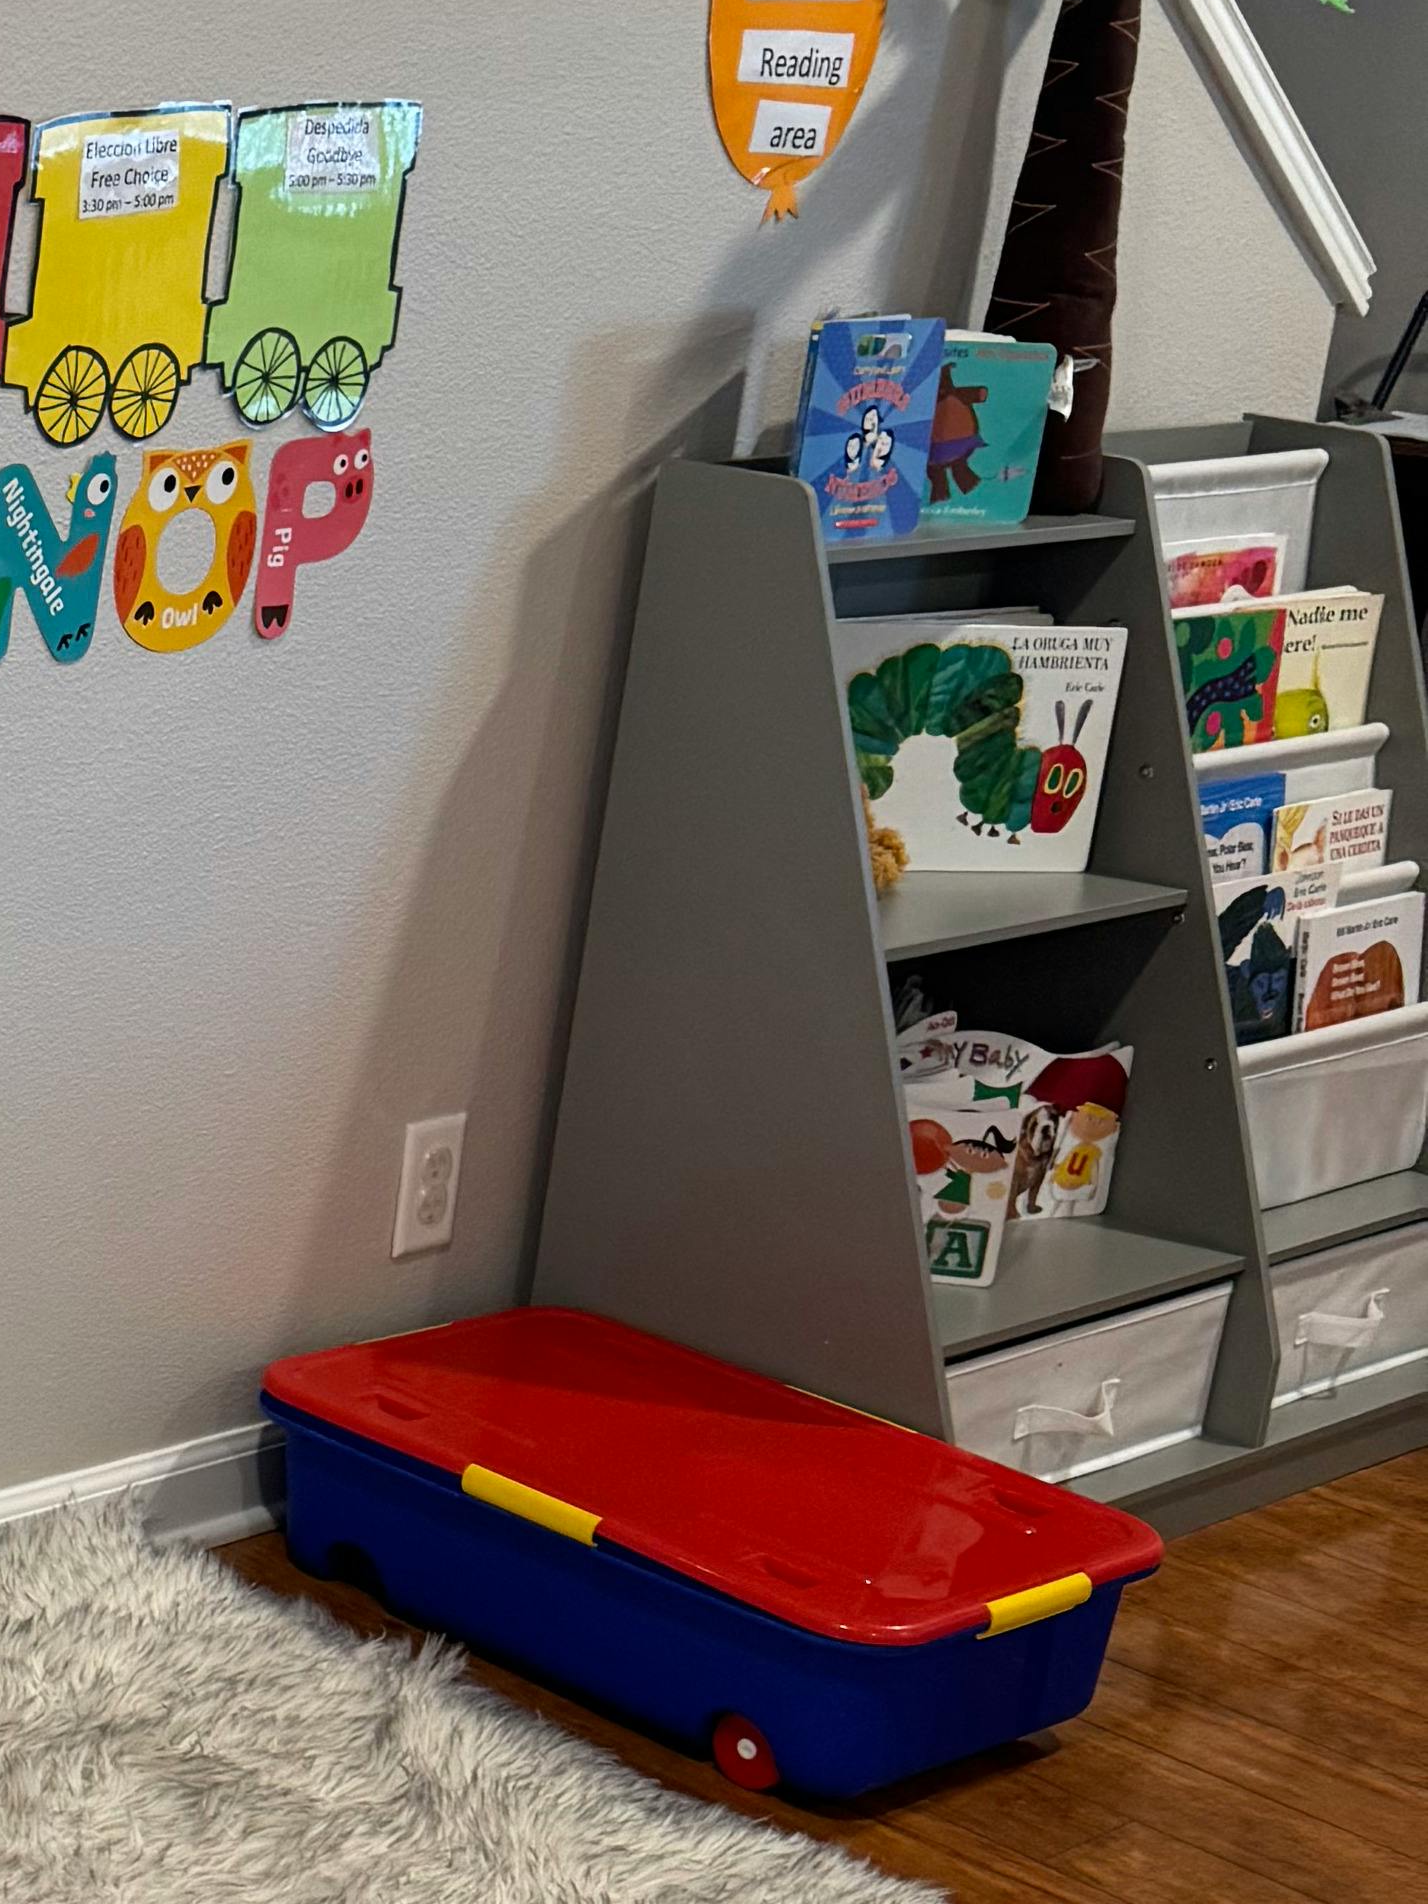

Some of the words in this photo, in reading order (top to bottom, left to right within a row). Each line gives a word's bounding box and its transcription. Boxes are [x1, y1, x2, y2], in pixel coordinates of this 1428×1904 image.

[760, 48, 843, 85] Reading
[145, 136, 177, 154] Libre
[769, 123, 817, 150] area
[91, 171, 121, 188] Free
[124, 166, 169, 185] Choice
[2, 477, 64, 616] Nightingale
[266, 527, 292, 567] Pig
[161, 602, 198, 630] Owl
[1288, 605, 1335, 626] Nadie
[1339, 606, 1368, 622] me
[1083, 637, 1112, 652] MUY
[1018, 655, 1109, 671] HAMBRIENTA
[969, 1043, 1030, 1081] Baby
[933, 1232, 972, 1268] A
